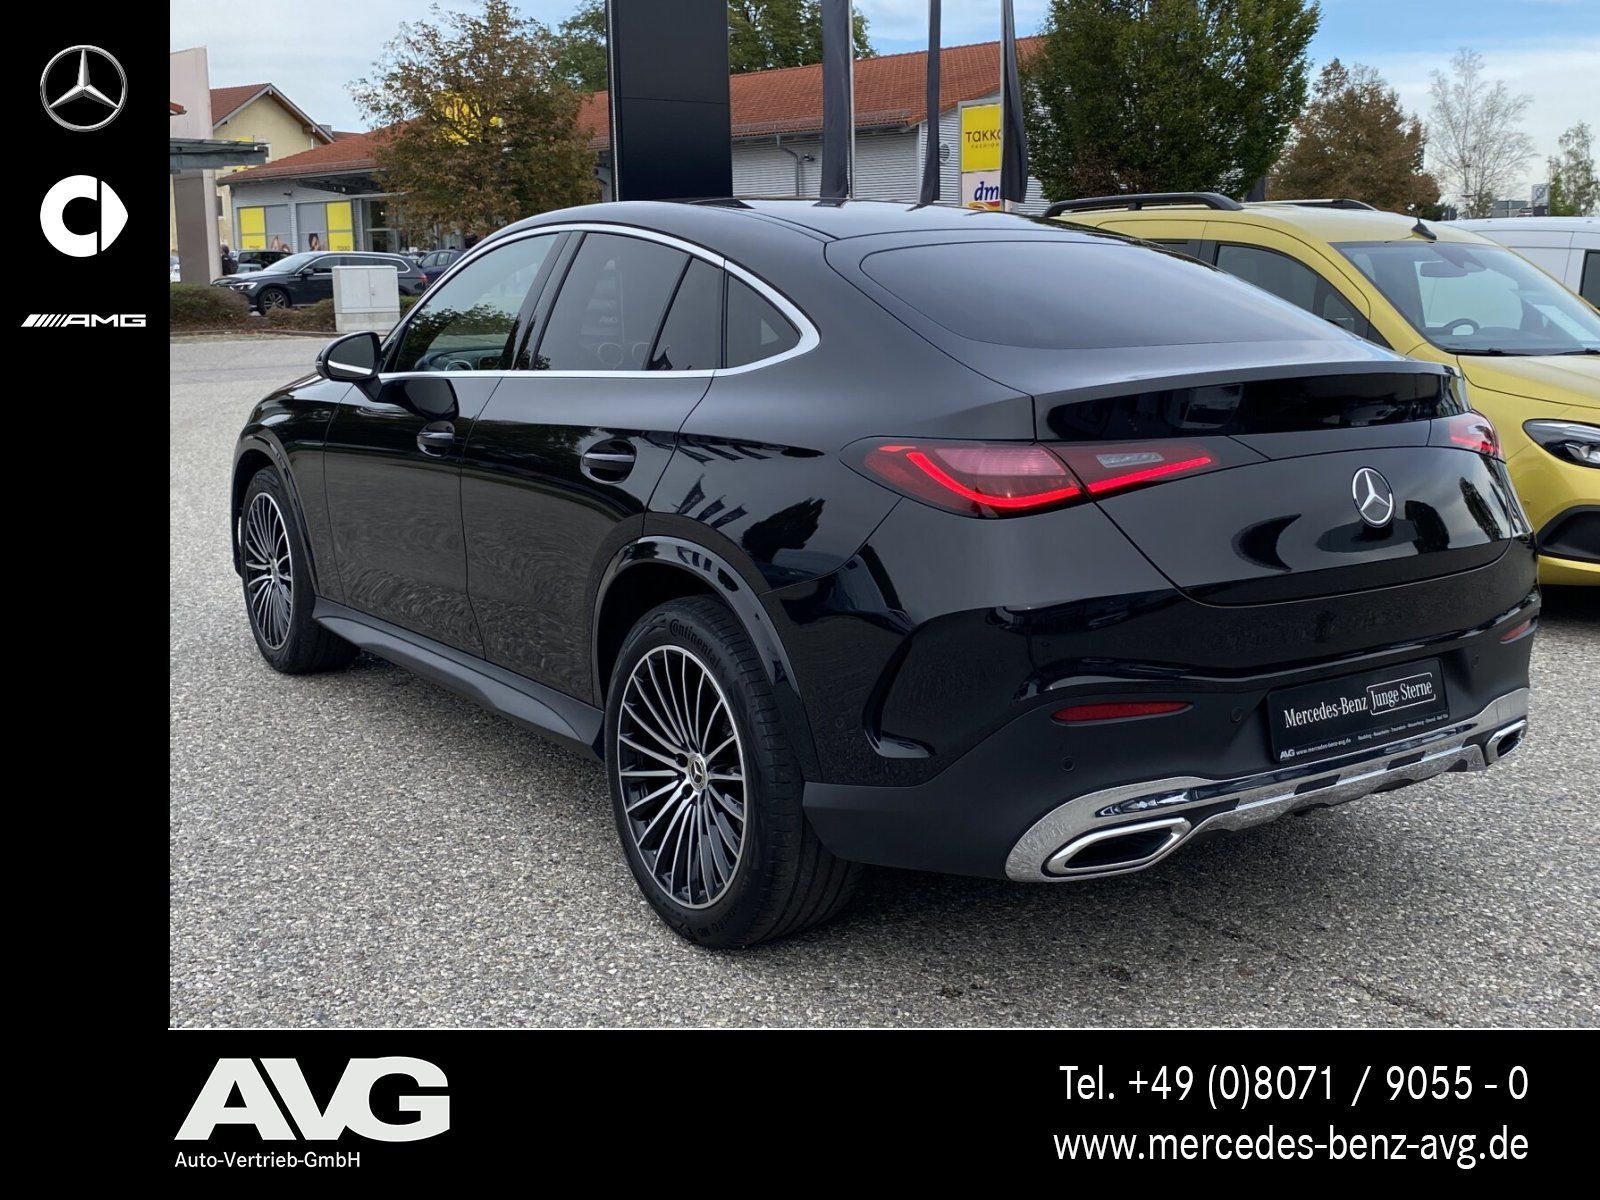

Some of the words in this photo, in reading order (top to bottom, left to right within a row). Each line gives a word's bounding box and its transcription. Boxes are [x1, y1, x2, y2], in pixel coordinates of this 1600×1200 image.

[974, 181, 999, 201] dm
[670, 619, 721, 669] Continental
[1284, 697, 1368, 728] Mercedes-Benz
[1371, 689, 1400, 711] Junge
[1400, 681, 1433, 700] Sterne
[1280, 749, 1296, 759] AVG
